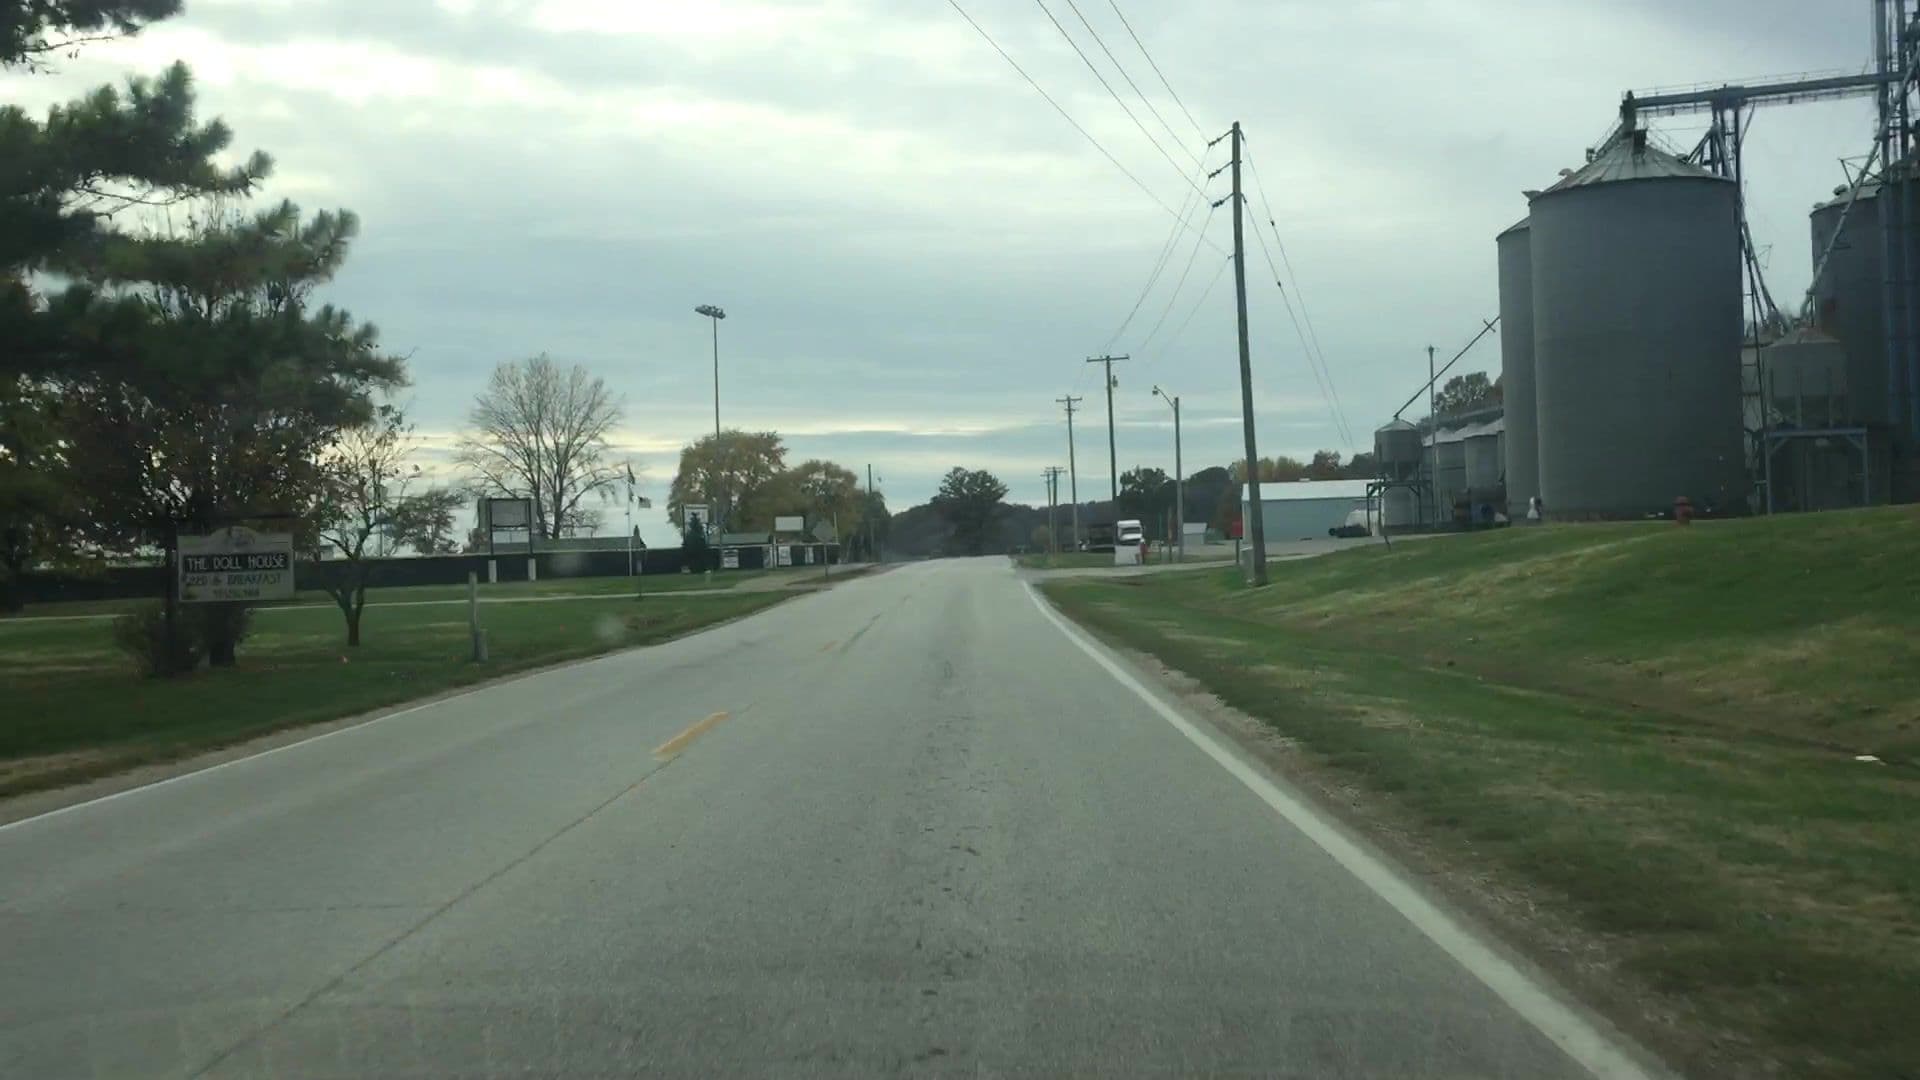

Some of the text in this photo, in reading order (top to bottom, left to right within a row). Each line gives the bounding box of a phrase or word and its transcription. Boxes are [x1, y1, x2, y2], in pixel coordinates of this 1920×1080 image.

[187, 553, 286, 571] THE DOLL HOUSE
[227, 572, 281, 585] BREAKFAST
